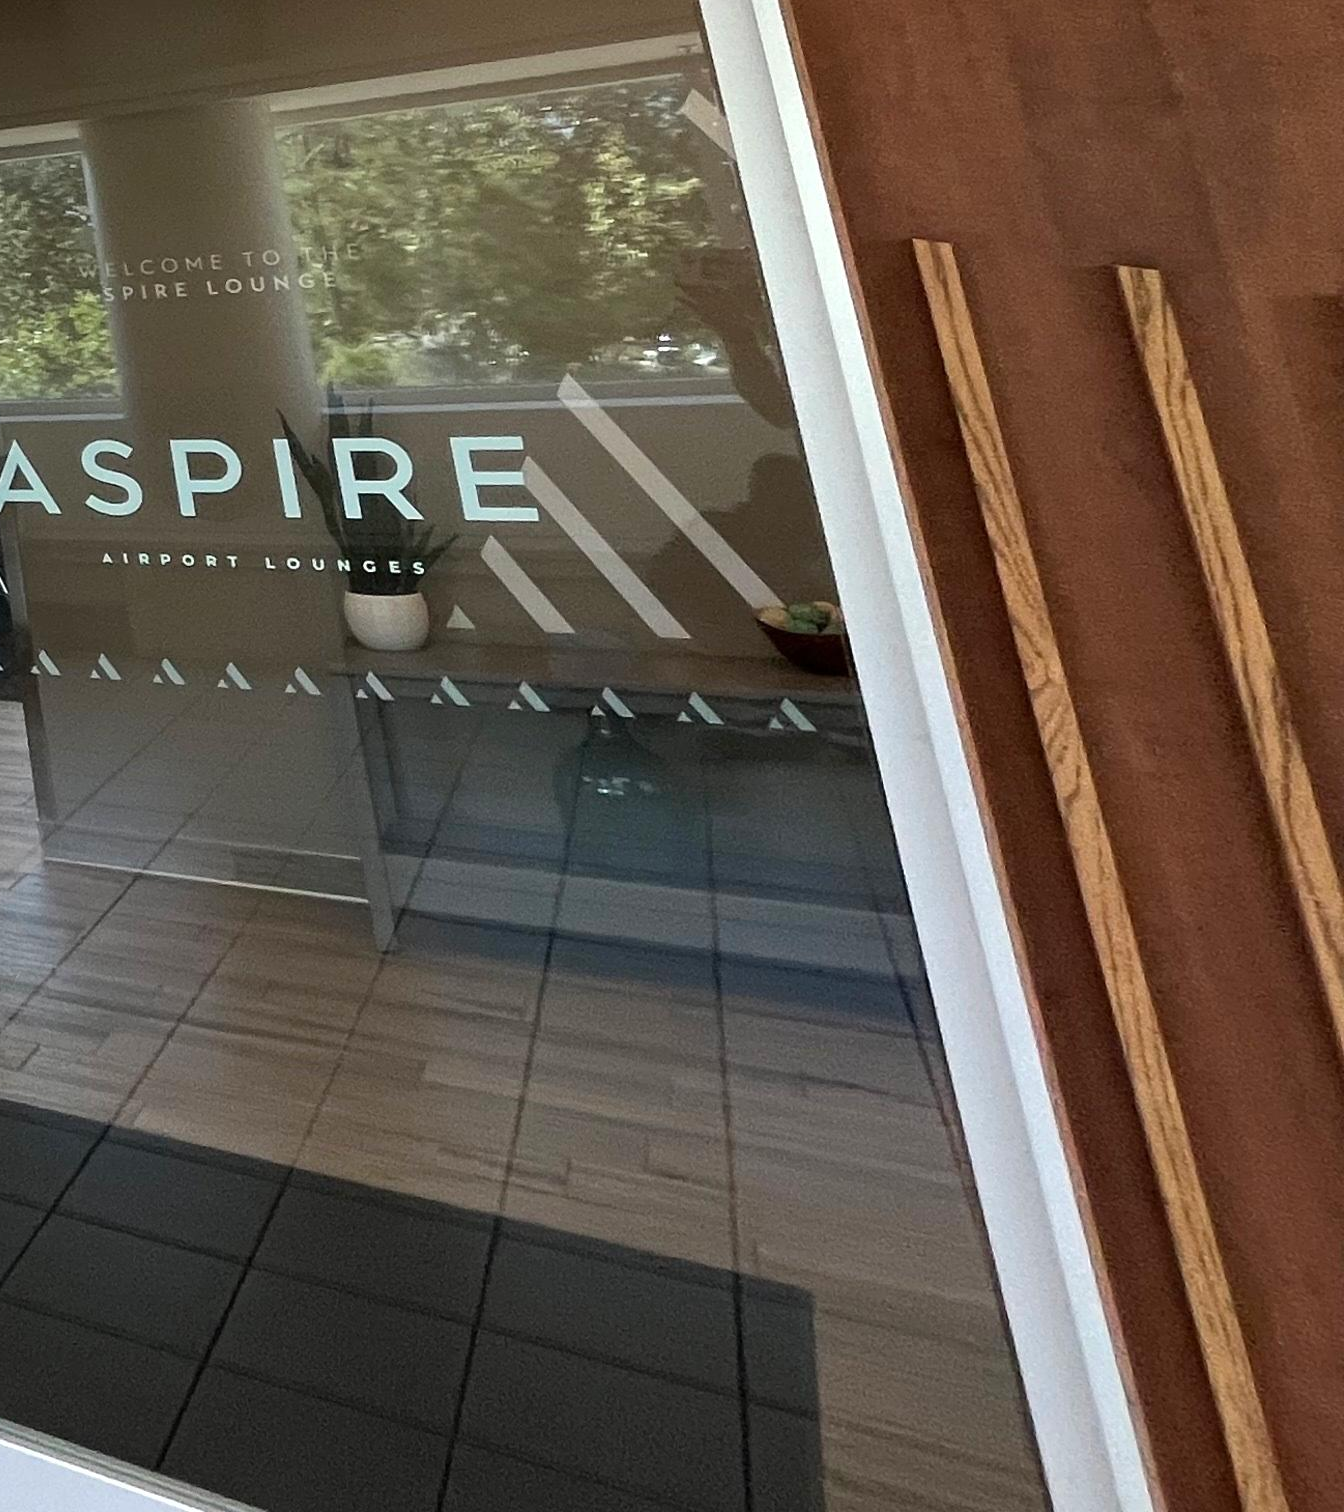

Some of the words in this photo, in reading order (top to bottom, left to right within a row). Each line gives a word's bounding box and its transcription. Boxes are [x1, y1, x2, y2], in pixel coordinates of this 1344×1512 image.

[78, 253, 223, 279] WELCOME
[242, 249, 281, 267] TO
[300, 242, 361, 263] THE
[100, 281, 188, 303] SPIRE
[206, 272, 337, 296] LOUNGE
[101, 552, 238, 569] AIRPORT
[265, 556, 426, 576] LOUNGES
